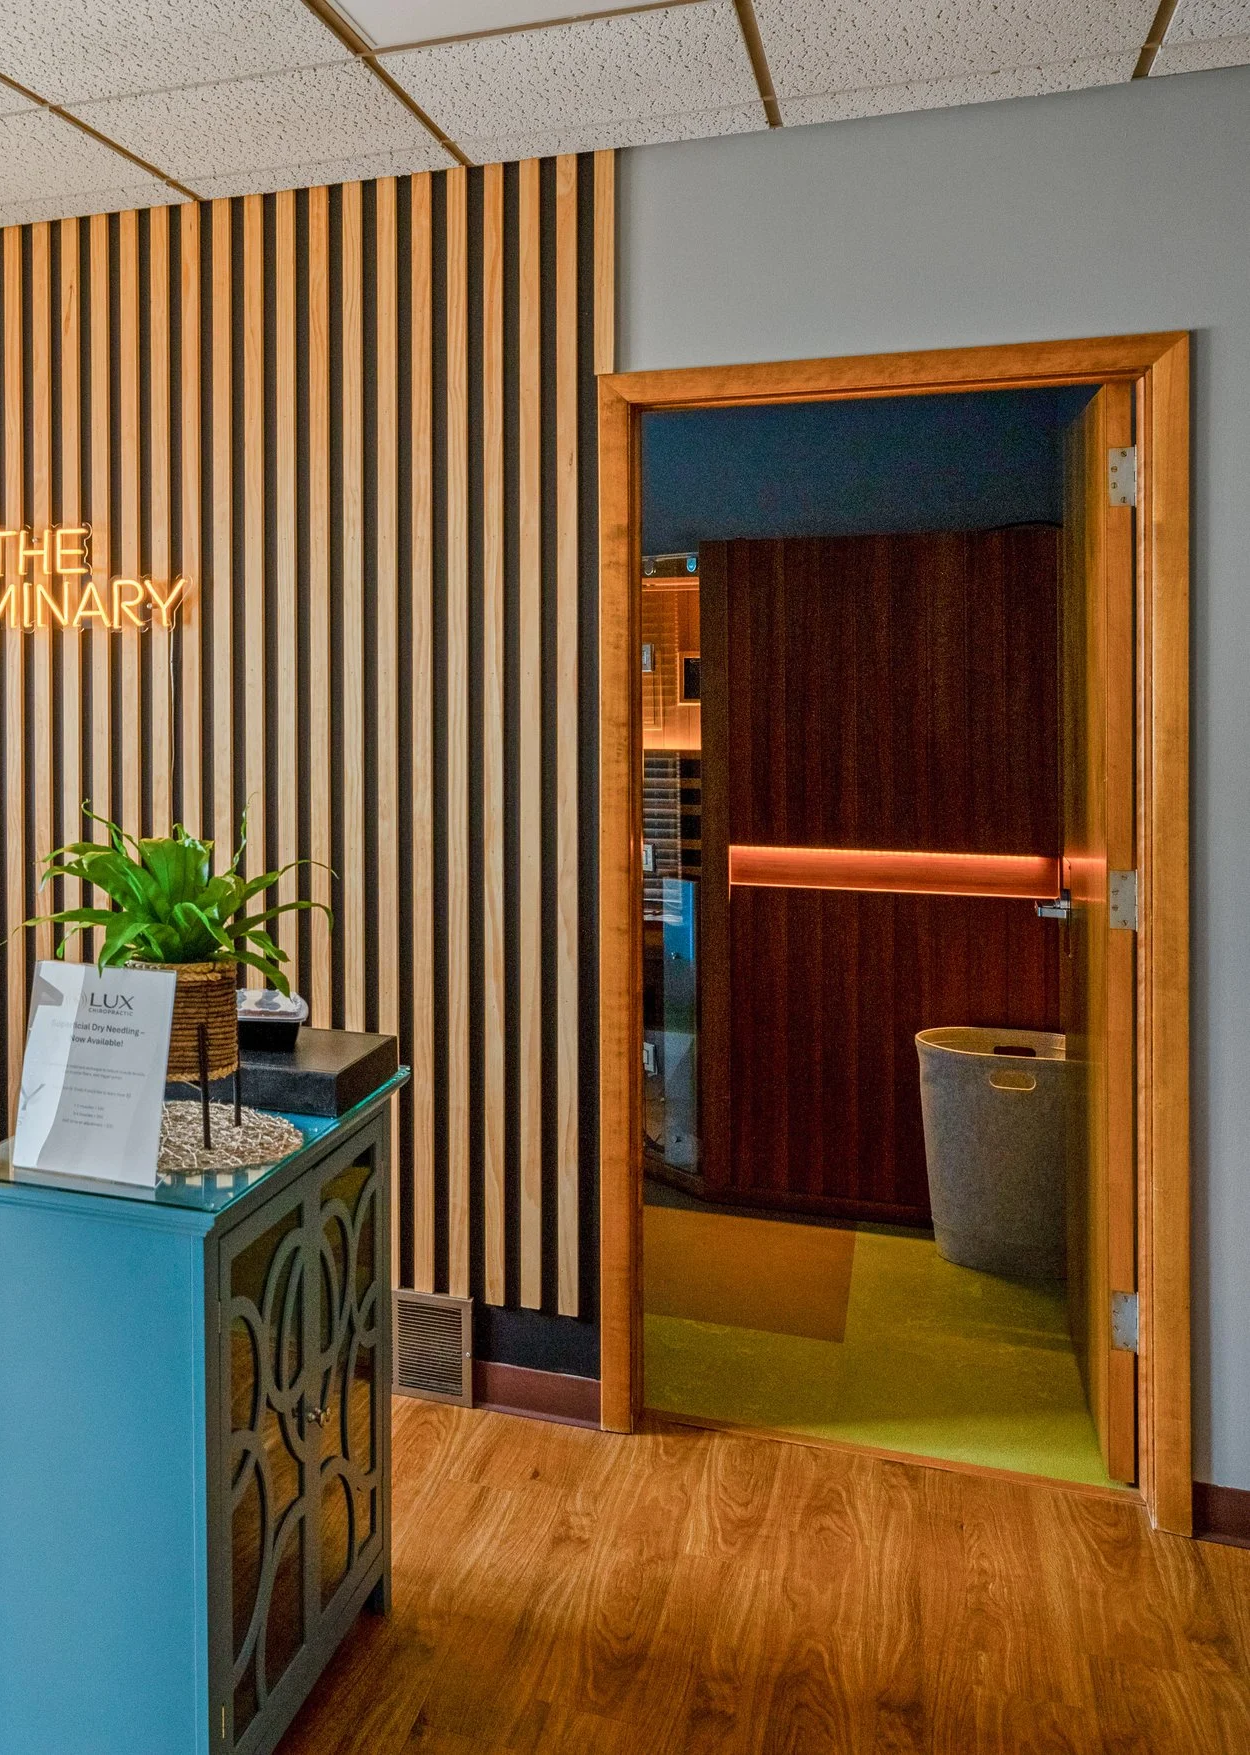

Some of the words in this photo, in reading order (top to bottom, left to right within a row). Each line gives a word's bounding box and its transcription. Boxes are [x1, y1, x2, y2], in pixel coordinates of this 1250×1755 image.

[90, 992, 135, 1010] LUX
[88, 1007, 134, 1017] CHIROPRACTIC
[91, 1023, 105, 1033] Dry
[106, 1025, 140, 1037] Needling
[71, 1035, 86, 1044] Now
[87, 1037, 124, 1047] Available!
